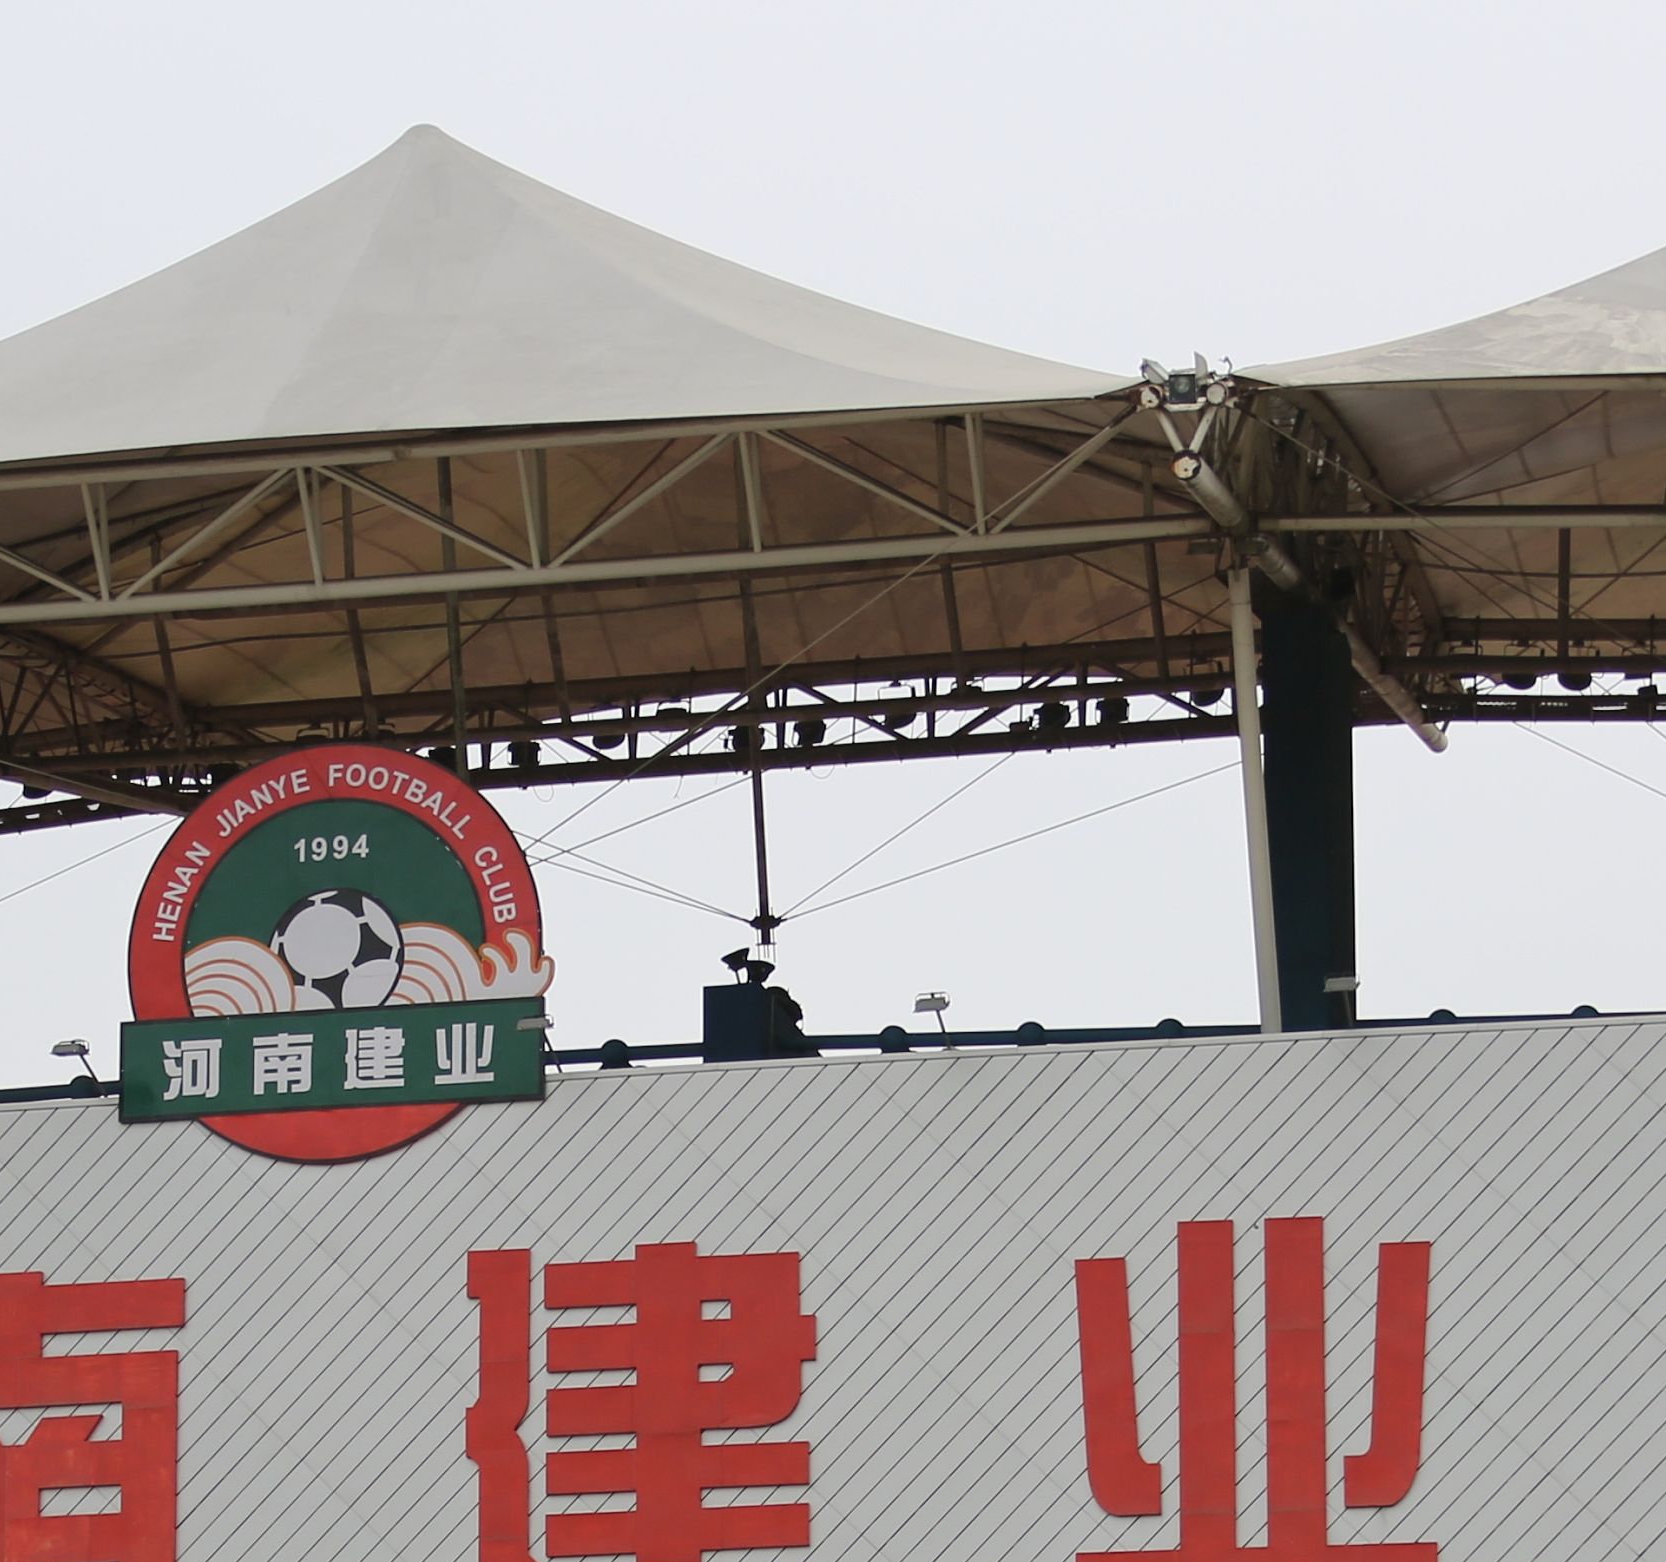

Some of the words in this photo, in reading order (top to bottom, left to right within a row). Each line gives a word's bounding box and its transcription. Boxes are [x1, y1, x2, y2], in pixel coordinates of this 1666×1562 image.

[152, 841, 211, 942] HENAN
[218, 769, 311, 838] JIANYE
[328, 763, 471, 840] FOOTBALL
[474, 846, 517, 923] CLUB
[294, 834, 369, 862] 1994
[162, 1022, 494, 1100] 河南建业
